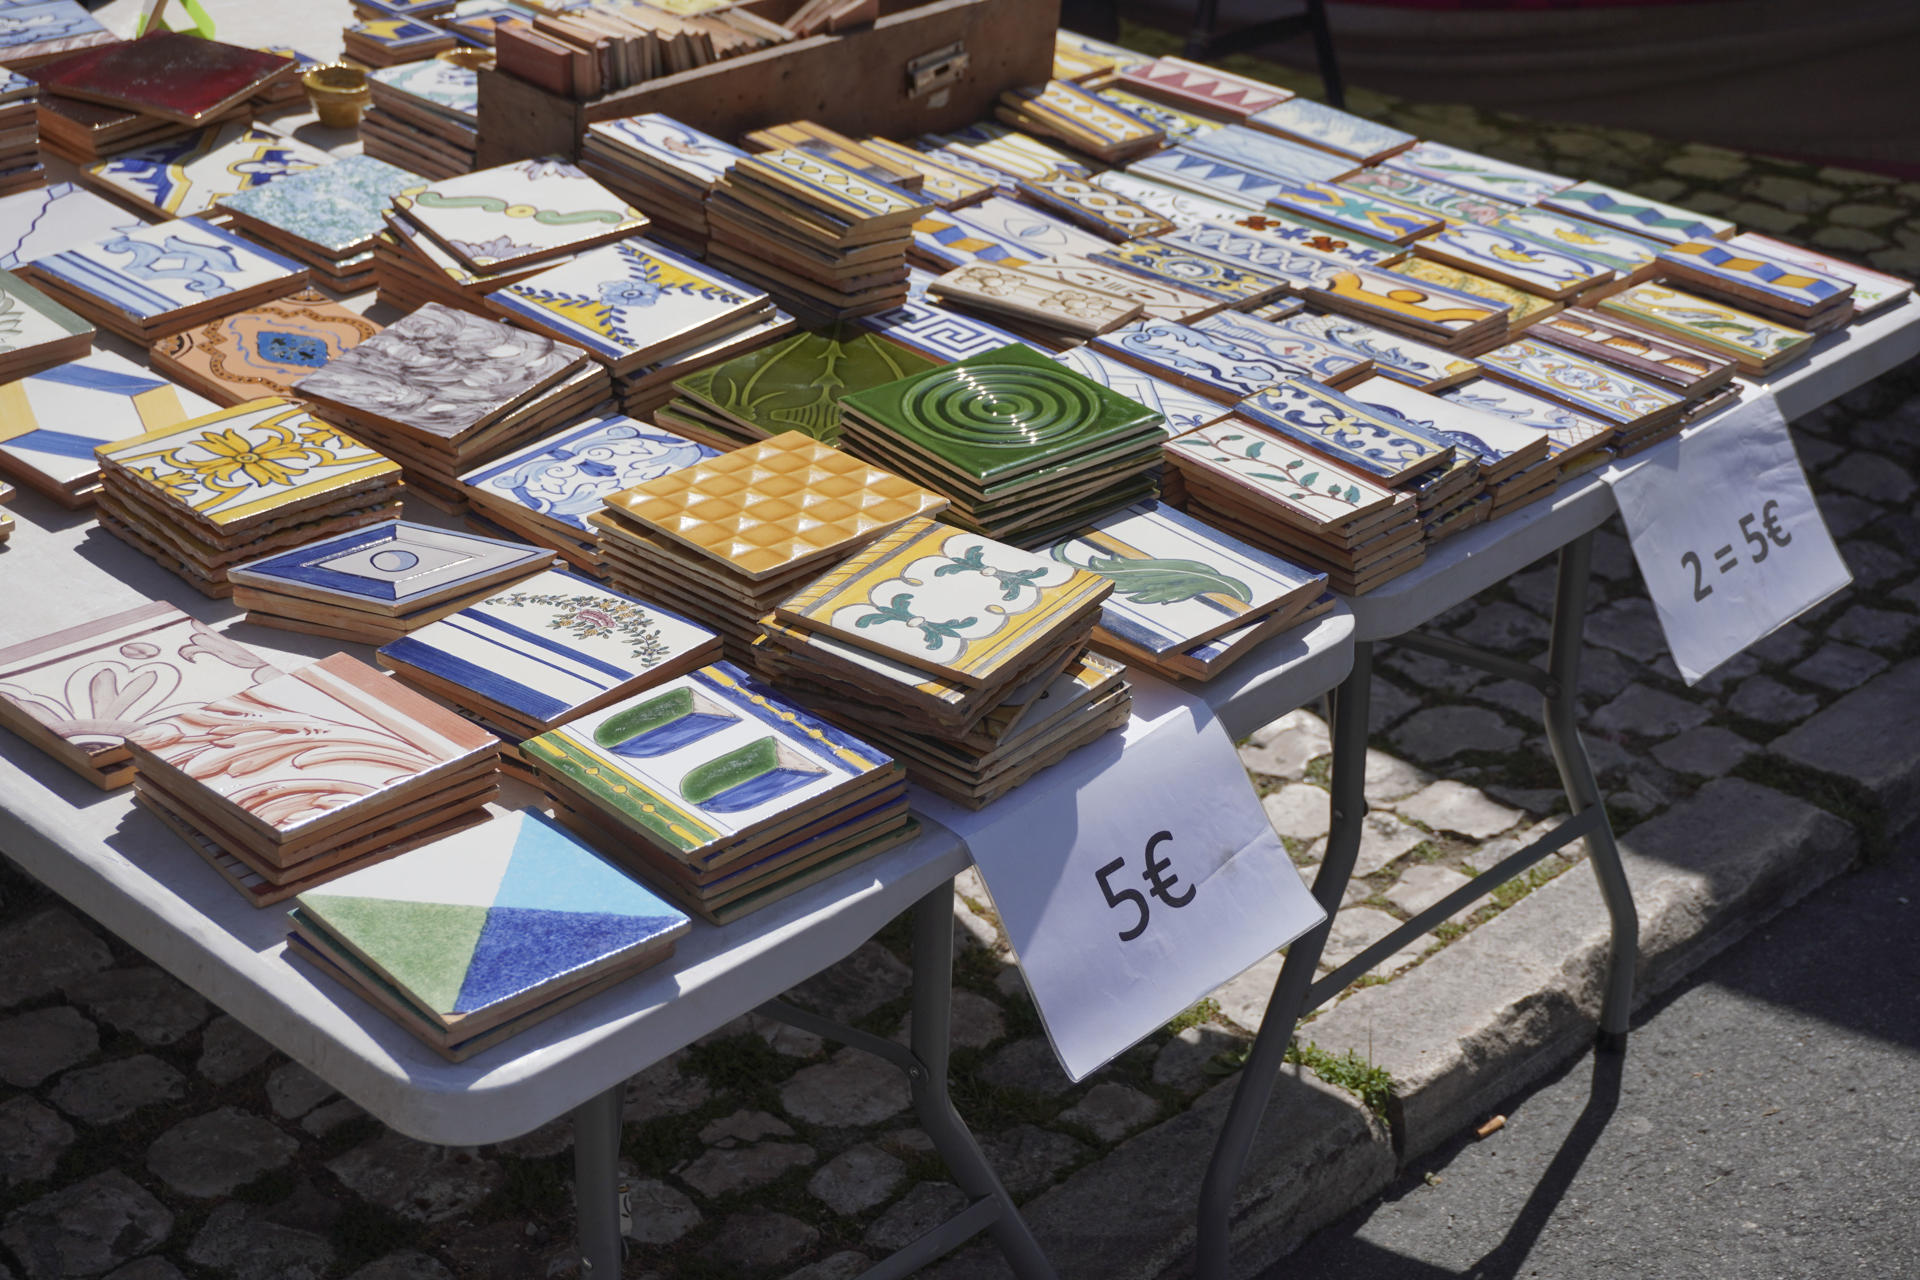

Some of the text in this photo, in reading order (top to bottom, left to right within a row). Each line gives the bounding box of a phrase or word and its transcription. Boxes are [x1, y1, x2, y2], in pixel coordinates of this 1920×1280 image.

[1681, 499, 1792, 602] 2 = 5€
[1095, 830, 1197, 942] 5€
